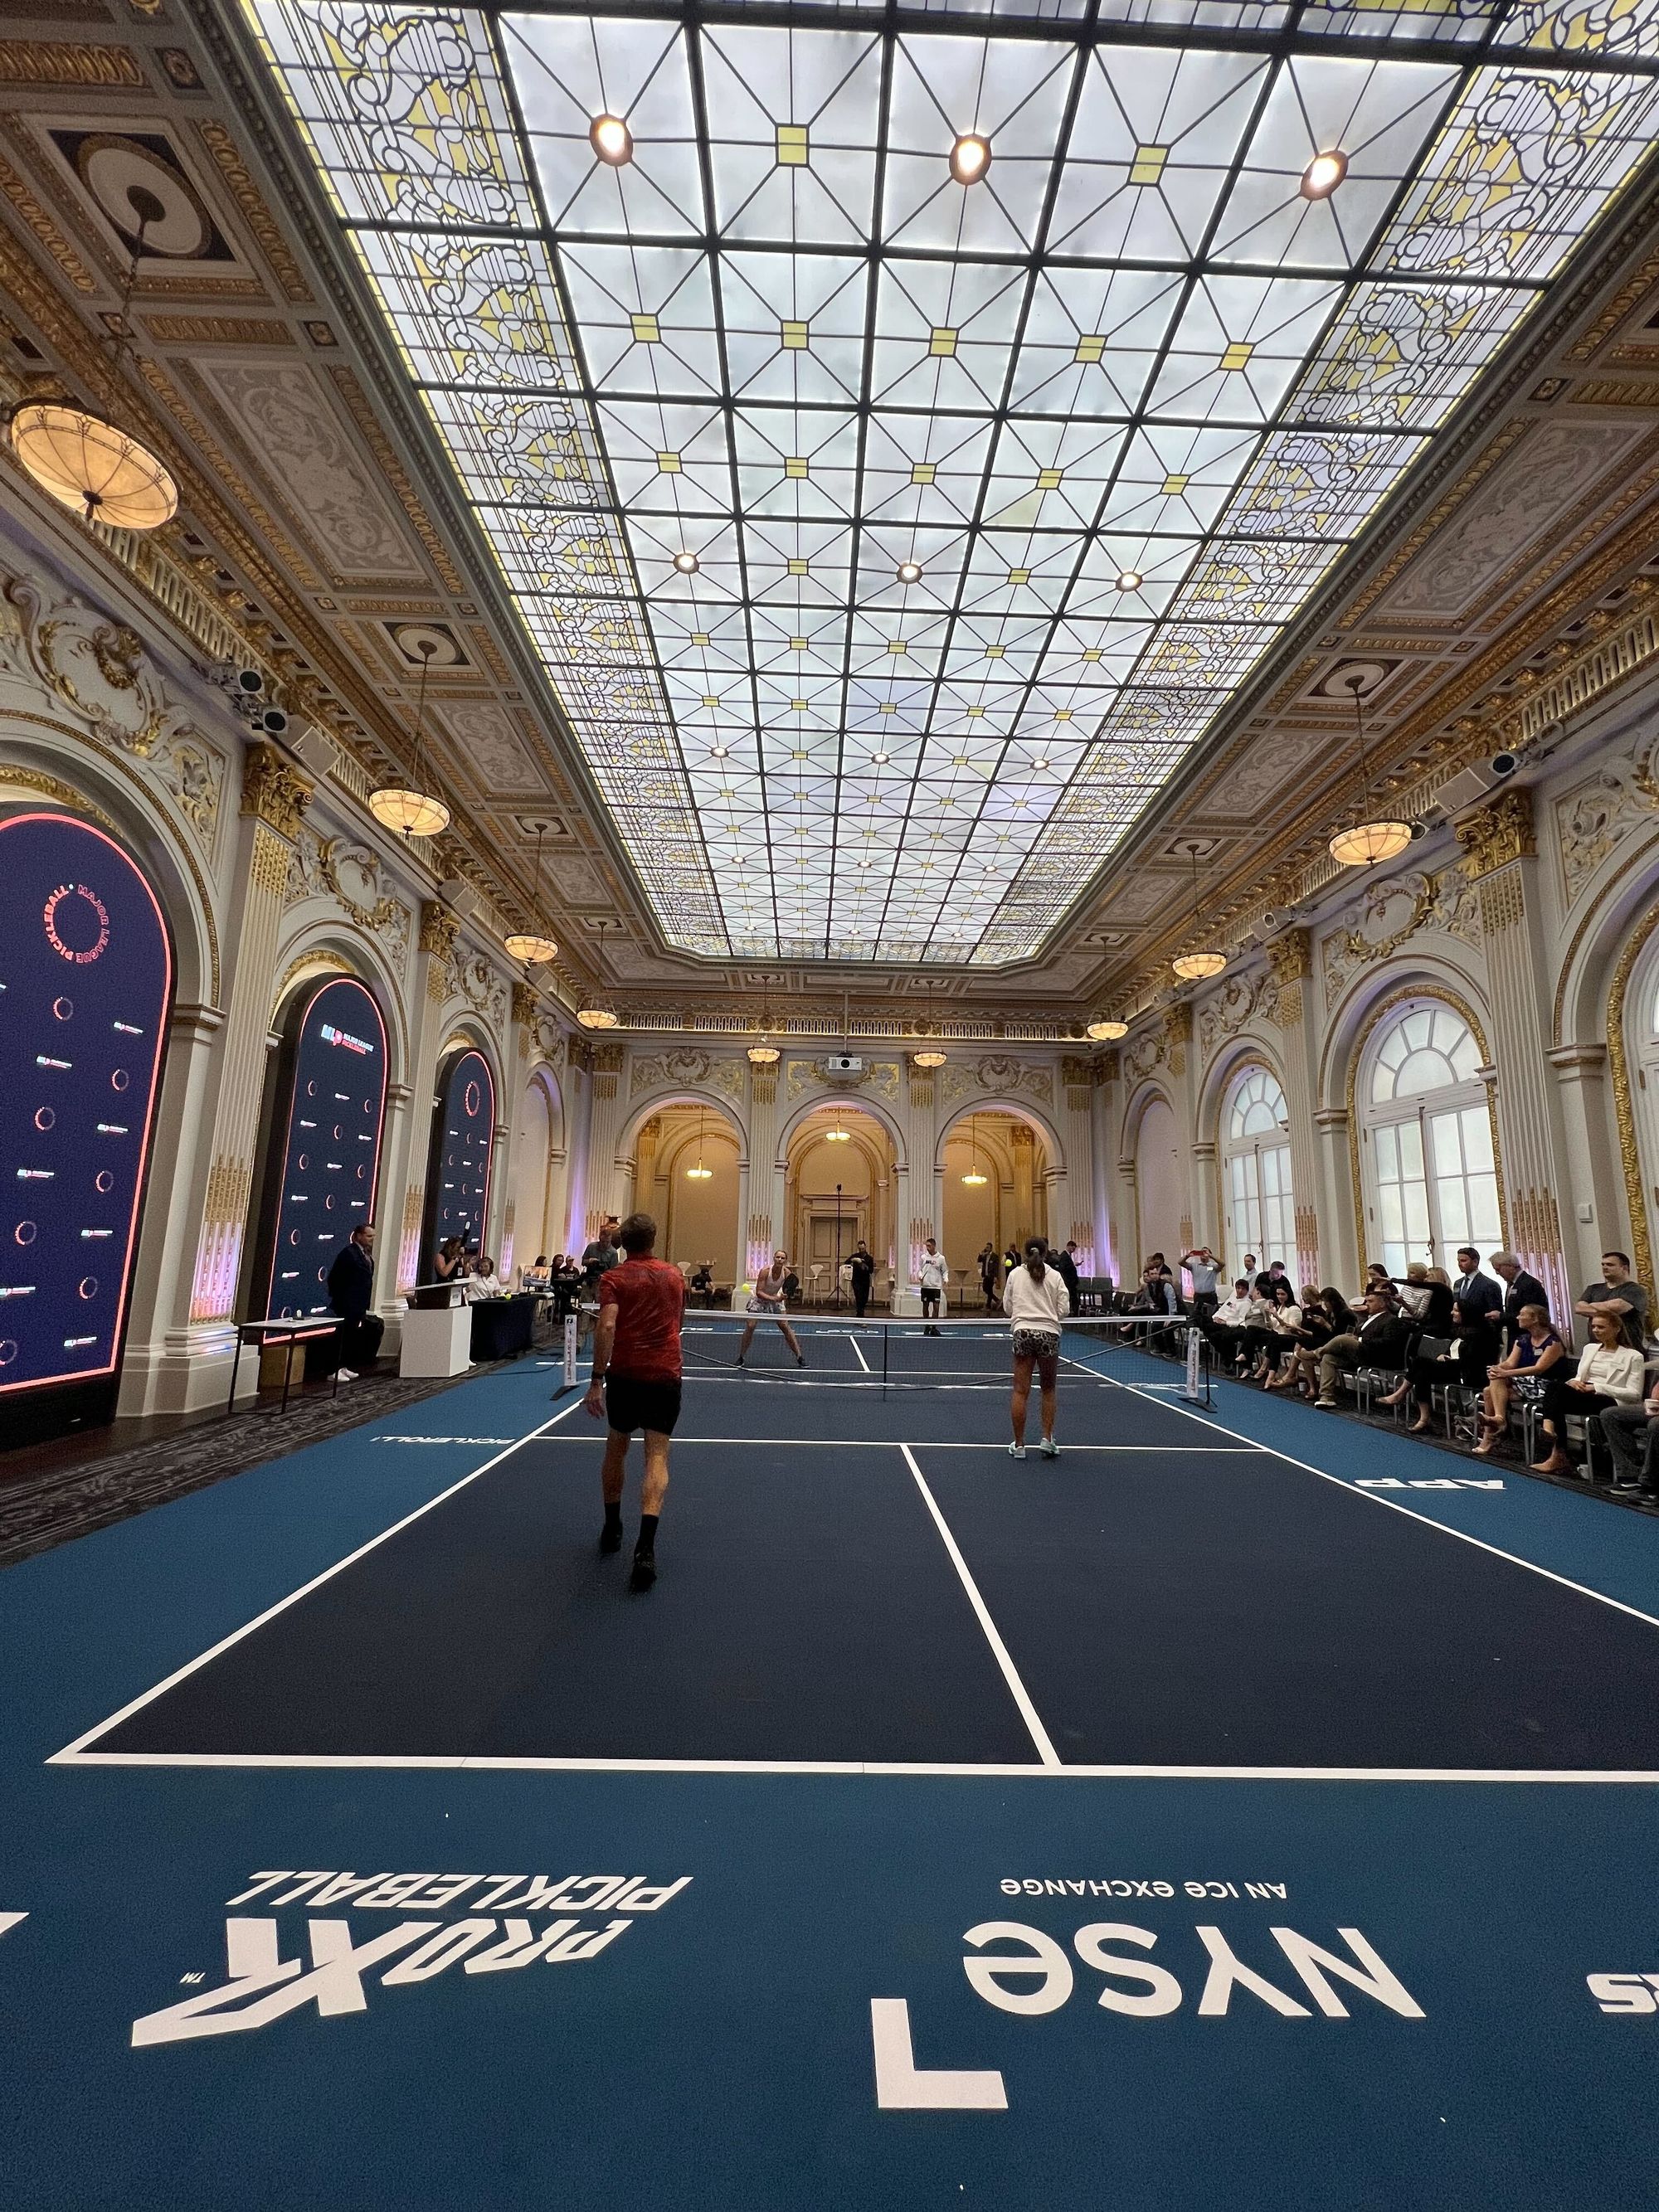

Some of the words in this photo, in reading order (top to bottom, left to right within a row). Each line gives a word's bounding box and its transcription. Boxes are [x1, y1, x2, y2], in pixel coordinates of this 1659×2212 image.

[44, 885, 74, 960] PICKLEBALL
[77, 884, 109, 926] MAJOR
[75, 927, 109, 963] LEAGUE
[382, 1436, 515, 1445] PICKLEROLL
[1355, 1477, 1507, 1489] APP
[226, 1871, 693, 1910] PICKLEBALL
[1244, 1883, 1287, 1898] AN
